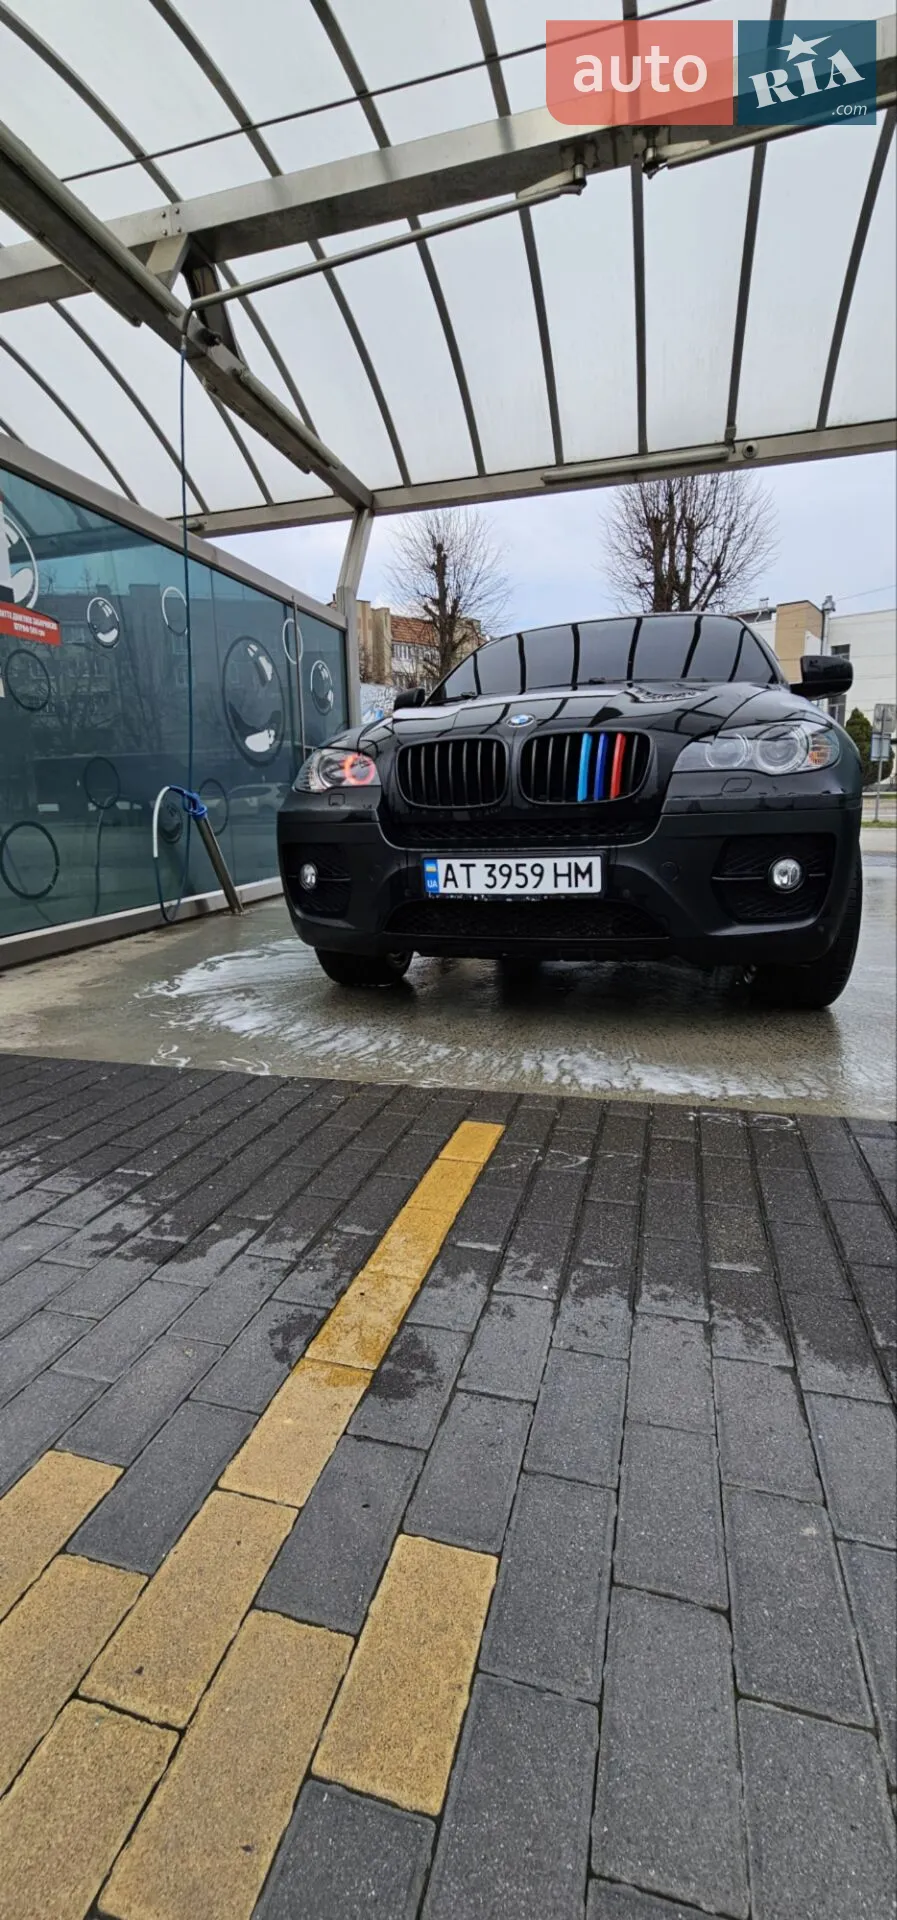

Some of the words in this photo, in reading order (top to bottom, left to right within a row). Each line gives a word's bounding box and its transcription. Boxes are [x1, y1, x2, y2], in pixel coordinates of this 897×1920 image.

[427, 879, 438, 888] UA
[443, 863, 477, 889] AT
[484, 863, 545, 889] 3959
[553, 861, 593, 889] HM
